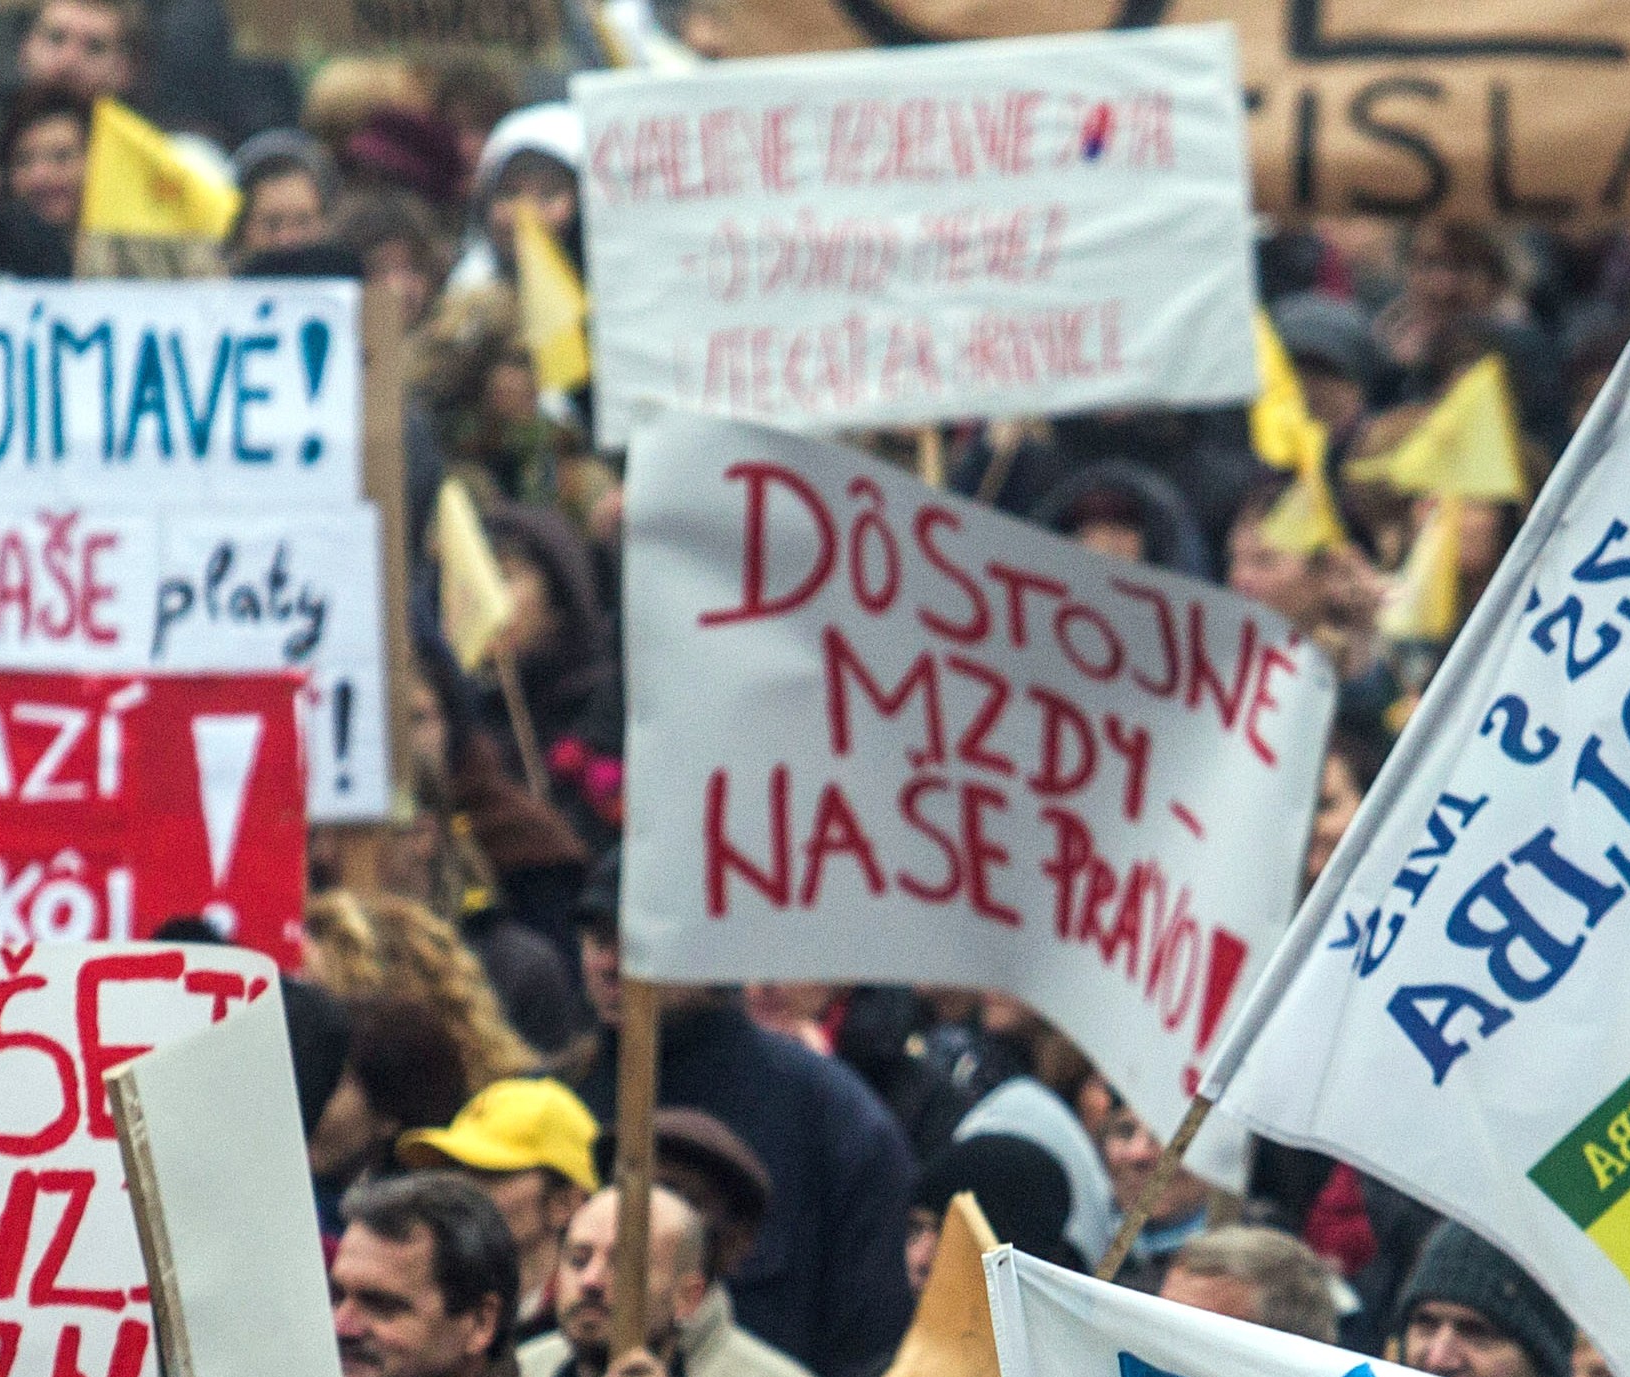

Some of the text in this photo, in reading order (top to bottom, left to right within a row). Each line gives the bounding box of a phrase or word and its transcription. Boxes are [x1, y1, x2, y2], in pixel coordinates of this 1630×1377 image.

[151, 541, 330, 661] platy
[697, 460, 1303, 770] DÔSTOJNÉ
[822, 622, 1153, 824] MZDY
